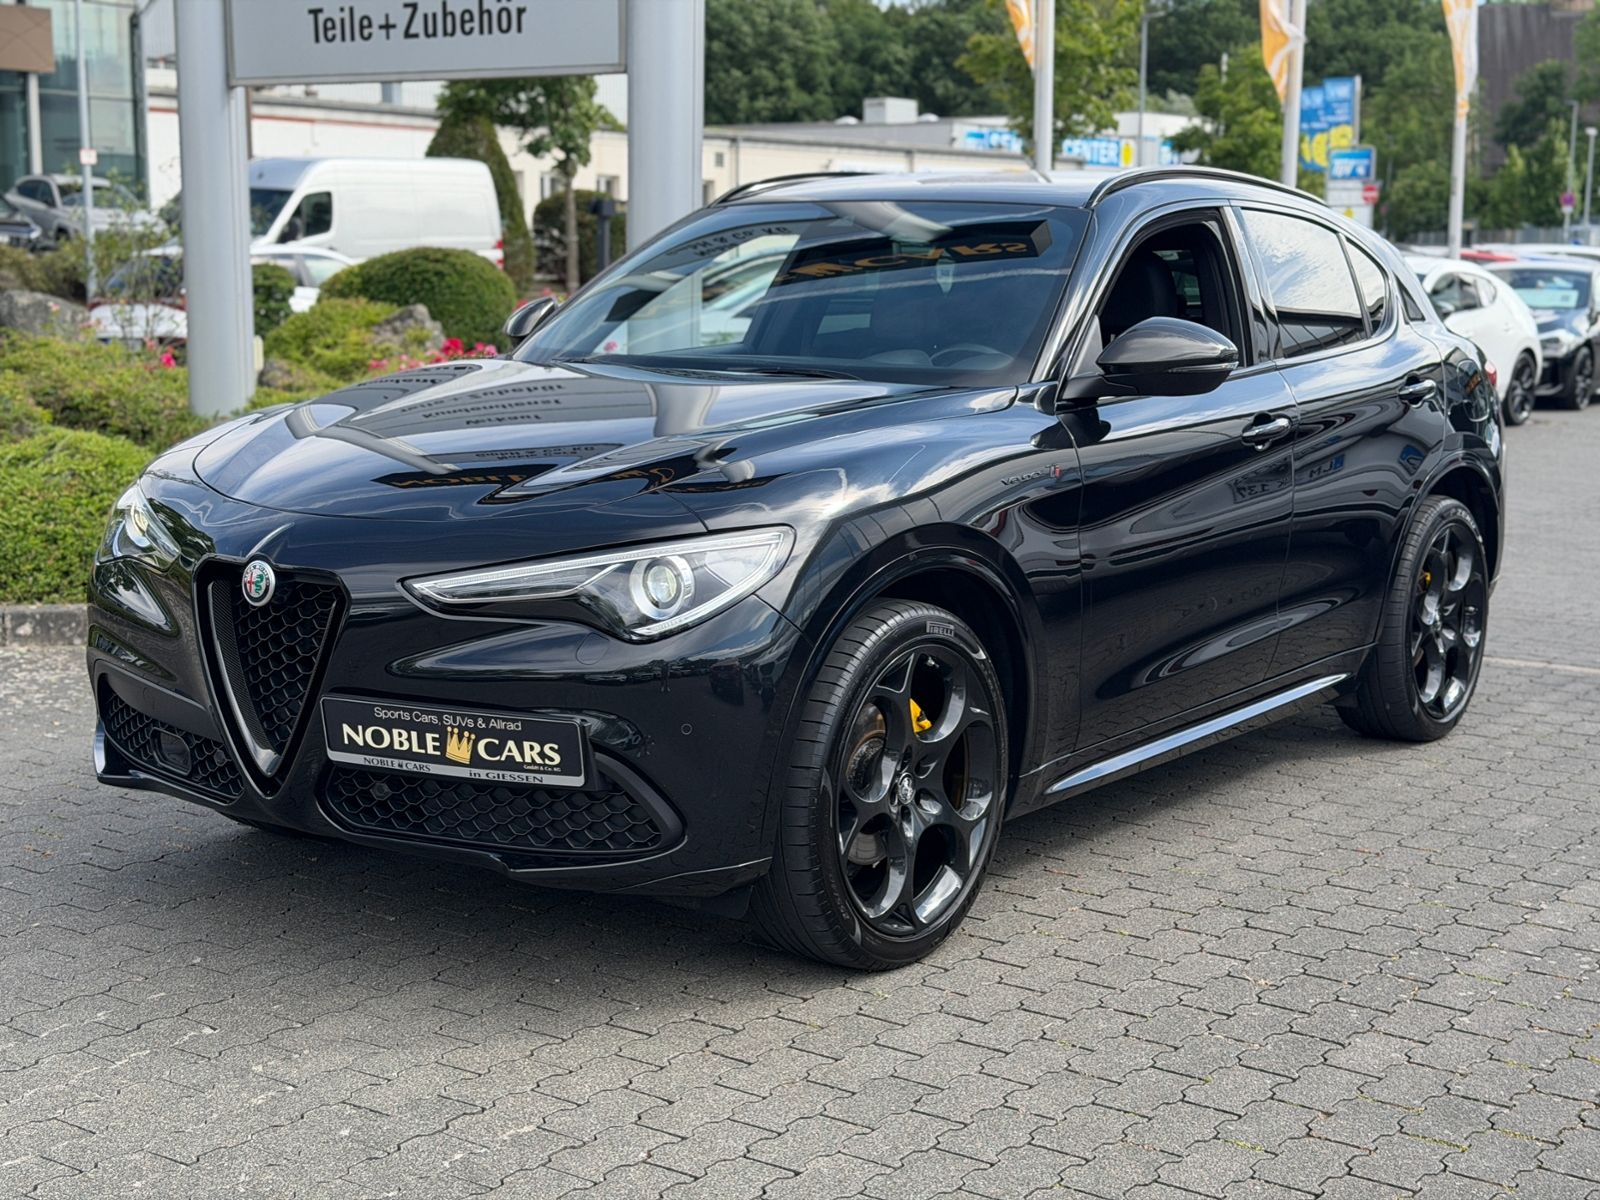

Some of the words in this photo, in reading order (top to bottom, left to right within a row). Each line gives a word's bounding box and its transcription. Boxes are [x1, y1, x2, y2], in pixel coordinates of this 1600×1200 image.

[926, 620, 954, 637] PIRELLI
[374, 706, 410, 721] Sports
[412, 711, 441, 726] Cars,
[442, 714, 474, 728] SUVs
[477, 718, 486, 729] &
[489, 718, 522, 731] Allrad
[342, 723, 441, 756] NOBLE
[477, 738, 561, 766] CARS
[363, 756, 397, 768] NOBLE
[405, 761, 431, 772] CARS
[469, 770, 481, 778] in
[485, 771, 543, 783] GIESSEN
